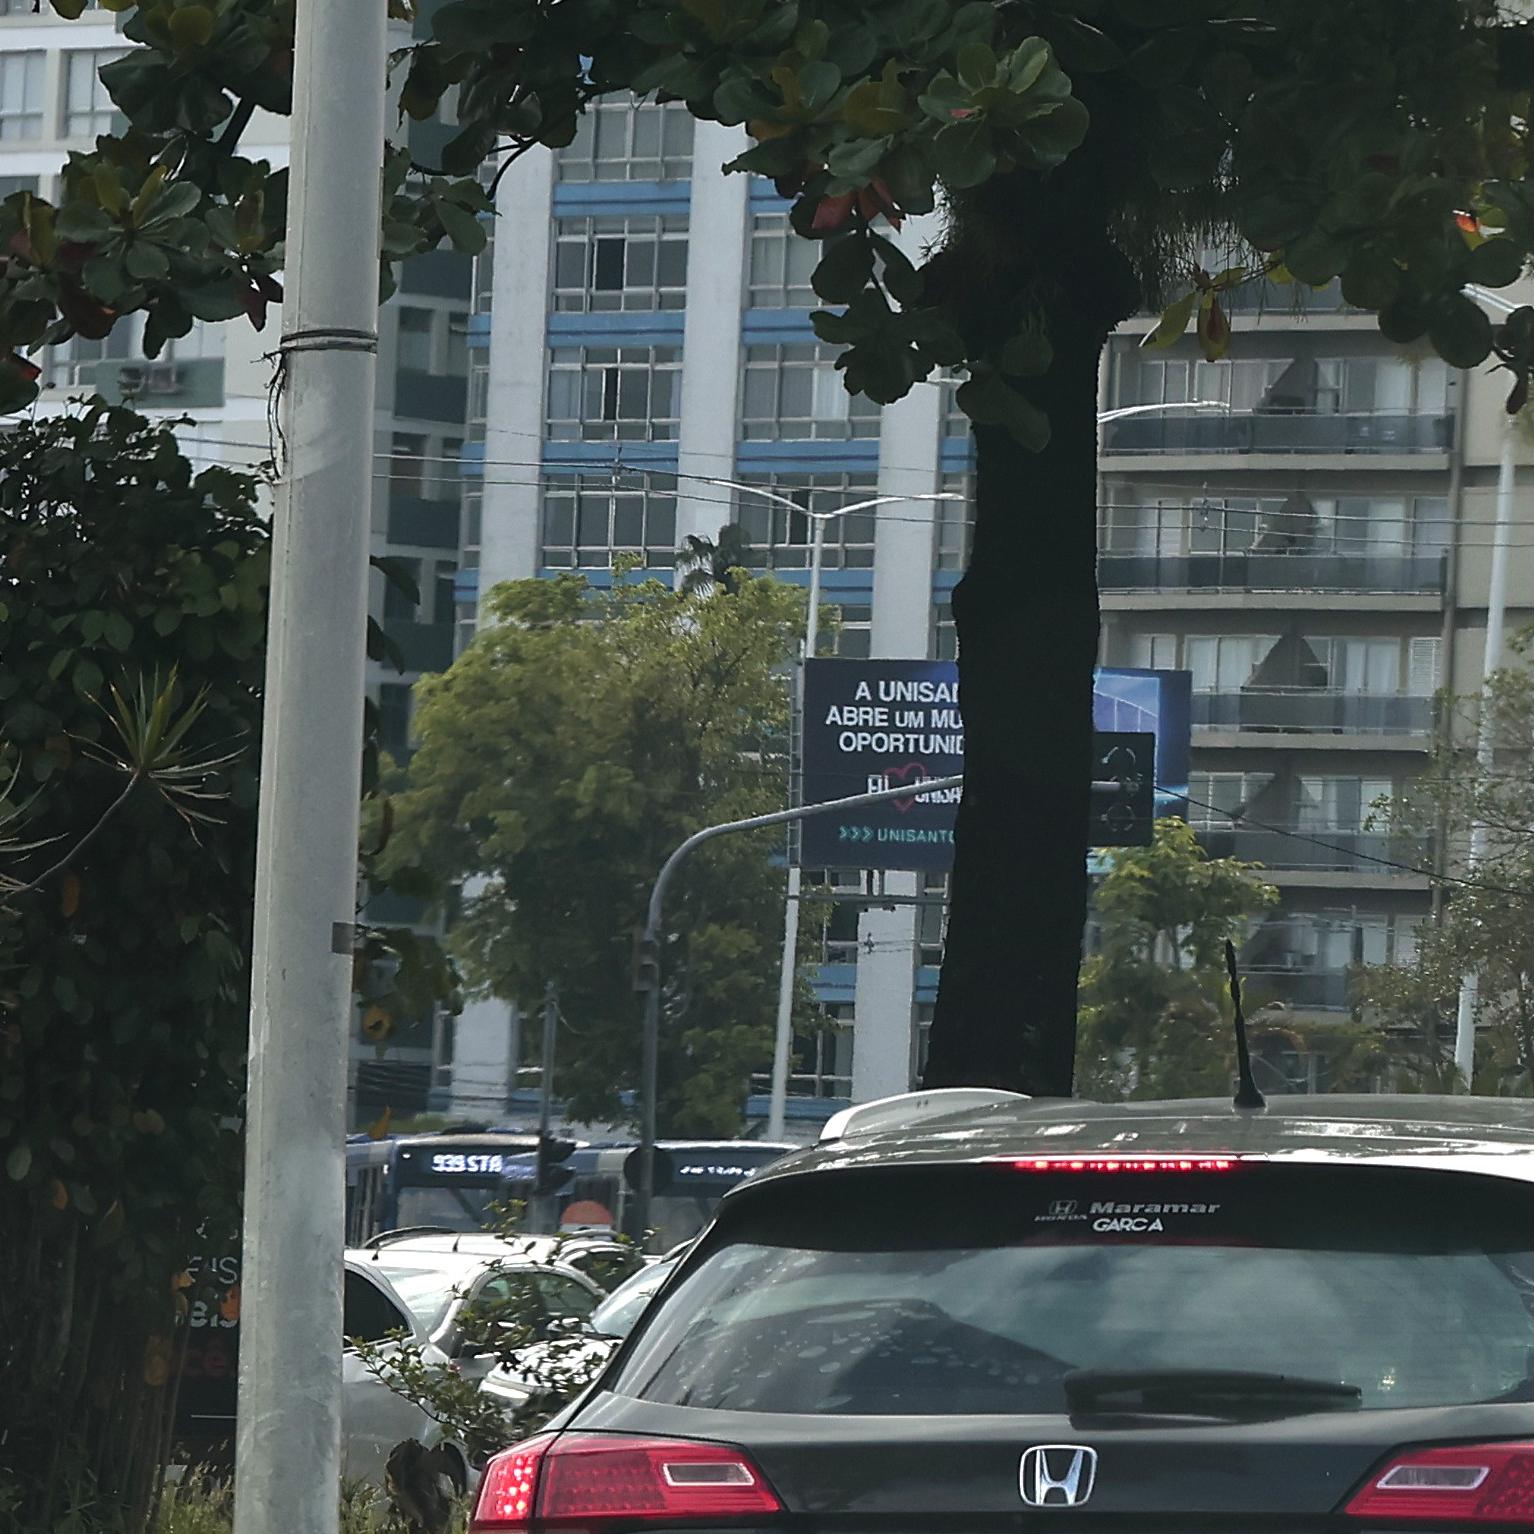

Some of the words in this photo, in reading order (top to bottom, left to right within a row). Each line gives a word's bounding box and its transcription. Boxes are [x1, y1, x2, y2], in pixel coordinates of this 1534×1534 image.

[855, 680, 872, 701] A
[825, 705, 889, 727] ABRE
[894, 711, 924, 729] UM
[1089, 1201, 1221, 1214] Maramar
